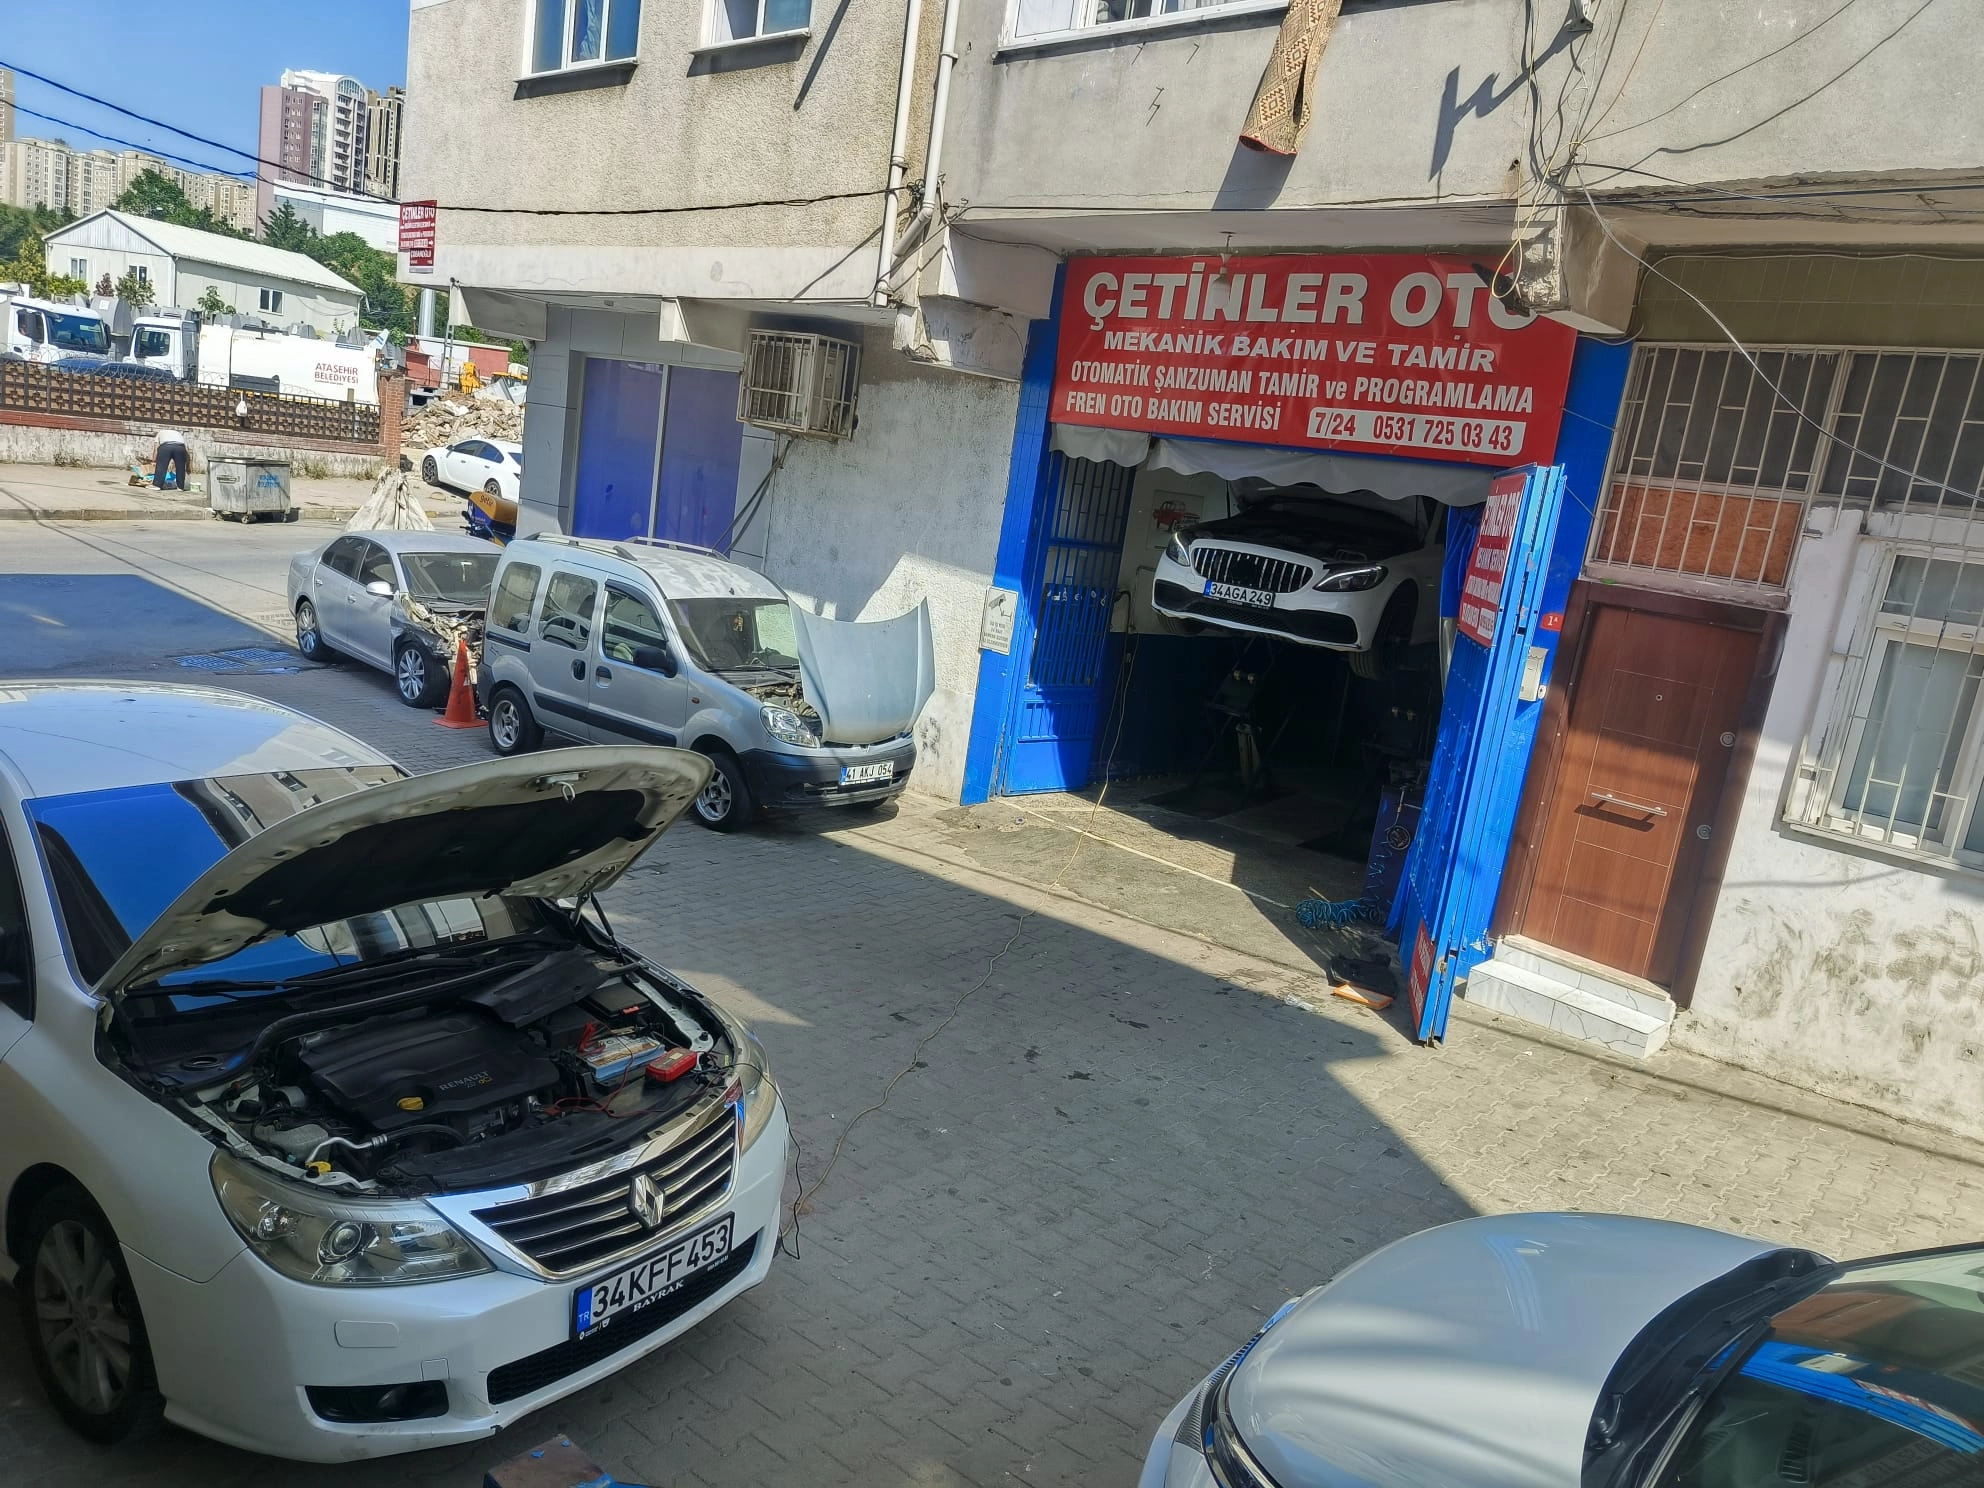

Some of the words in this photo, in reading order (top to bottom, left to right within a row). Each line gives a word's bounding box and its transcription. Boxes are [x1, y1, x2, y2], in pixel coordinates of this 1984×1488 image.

[1083, 262, 1368, 331] ÇETİNLER
[1104, 330, 1224, 355] MEKANİK
[1232, 336, 1328, 361] BAKIM
[1335, 340, 1377, 364] VE
[1388, 342, 1495, 373] TAMİR
[1071, 359, 1151, 386] OTOMATİK
[1154, 366, 1252, 394] ŞANZUMAN
[1259, 367, 1320, 399] TAMİR
[1325, 380, 1348, 400] ve
[1353, 377, 1533, 413] PROGRAMLAMA
[1066, 391, 1105, 415] FREN
[1110, 394, 1142, 418] OTO
[1147, 398, 1203, 423] BAKIM
[1207, 400, 1281, 430] SERVİSİ
[1315, 412, 1356, 437] 7/24
[1373, 415, 1416, 442] 0531
[1423, 419, 1455, 445] 725
[1461, 422, 1484, 449] 03
[1488, 424, 1513, 451] 43
[846, 767, 856, 779] 41
[859, 766, 874, 778] AKJ
[877, 764, 891, 776] 054
[632, 1279, 685, 1313] BAYRAK
[578, 1311, 590, 1323] TR
